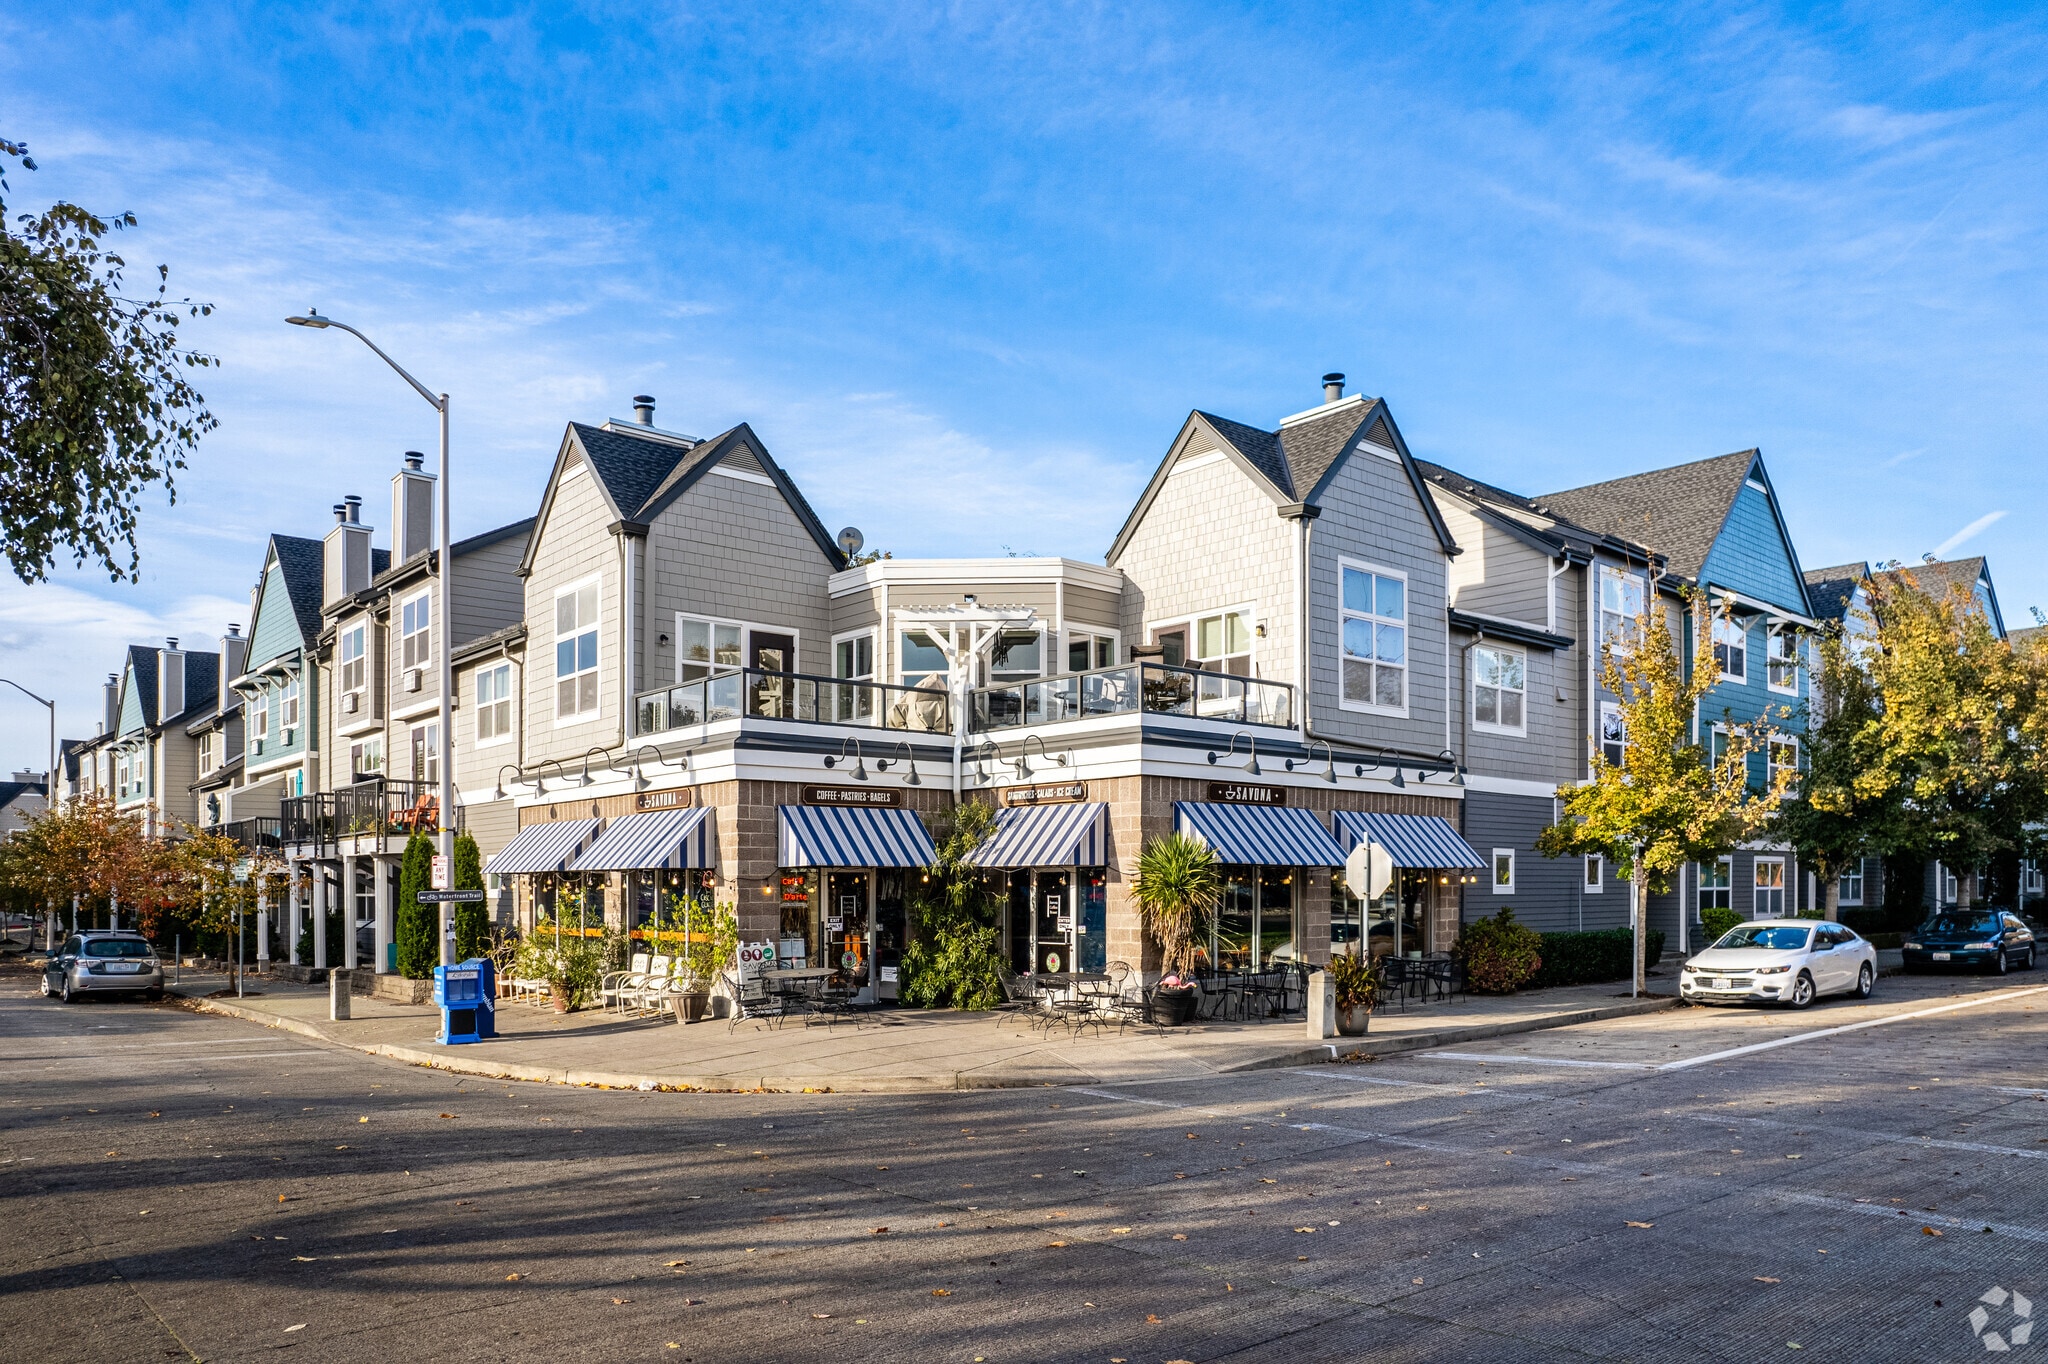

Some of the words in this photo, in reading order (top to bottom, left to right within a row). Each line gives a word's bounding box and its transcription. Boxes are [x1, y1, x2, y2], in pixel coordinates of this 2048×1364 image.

[816, 790, 837, 800] COFFEE
[840, 791, 867, 801] PASTRIES
[870, 792, 891, 802] BAGELS
[1037, 788, 1054, 798] SALADS
[1056, 787, 1064, 797] ICE
[1065, 786, 1082, 796] CREAM
[1236, 786, 1272, 802] SAVONA
[651, 791, 677, 808] SAVONA
[439, 892, 468, 900] Waterfront
